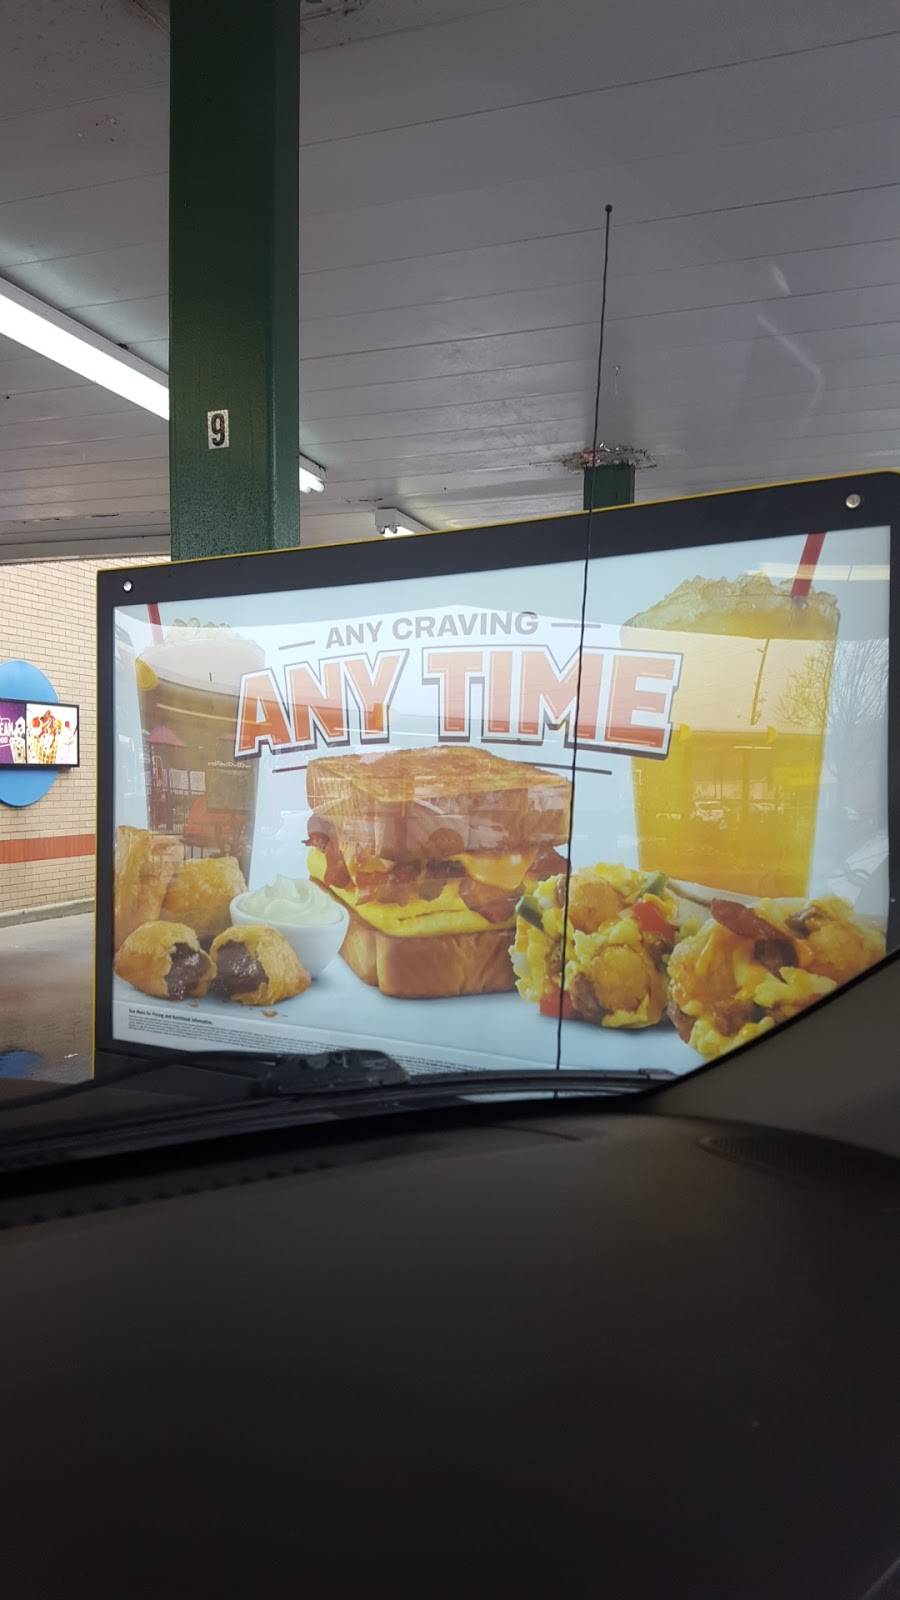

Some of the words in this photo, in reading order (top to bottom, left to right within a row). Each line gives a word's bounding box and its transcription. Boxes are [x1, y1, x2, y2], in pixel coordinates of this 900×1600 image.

[211, 413, 225, 446] 9
[325, 620, 383, 649] ANY
[391, 611, 539, 641] CRAVING
[234, 648, 409, 759] ANY
[422, 645, 684, 760] TIME
